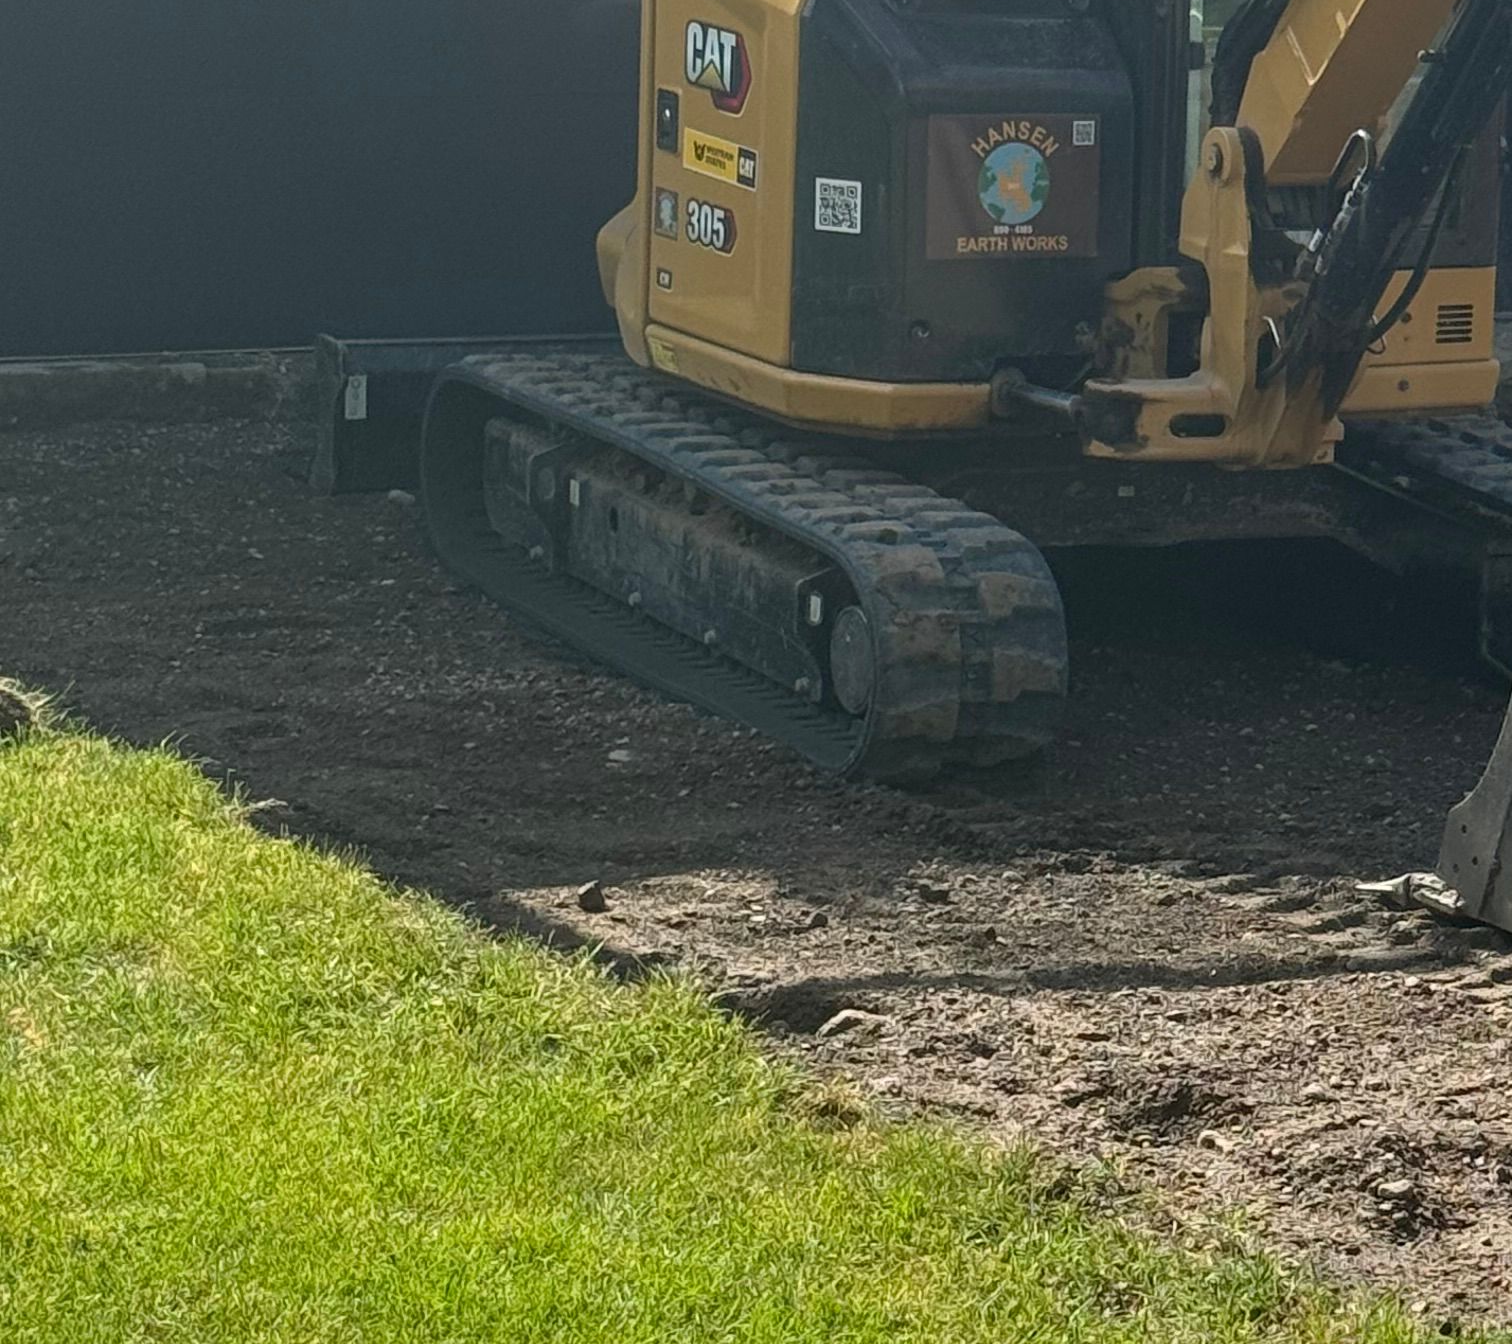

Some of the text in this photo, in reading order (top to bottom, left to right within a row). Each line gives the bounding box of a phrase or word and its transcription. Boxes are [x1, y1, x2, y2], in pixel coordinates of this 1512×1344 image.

[687, 22, 736, 93] CAT
[971, 121, 1060, 158] HANSEN
[739, 159, 754, 179] CAT
[687, 200, 726, 248] 305
[957, 236, 1069, 252] EARTH WORKS
